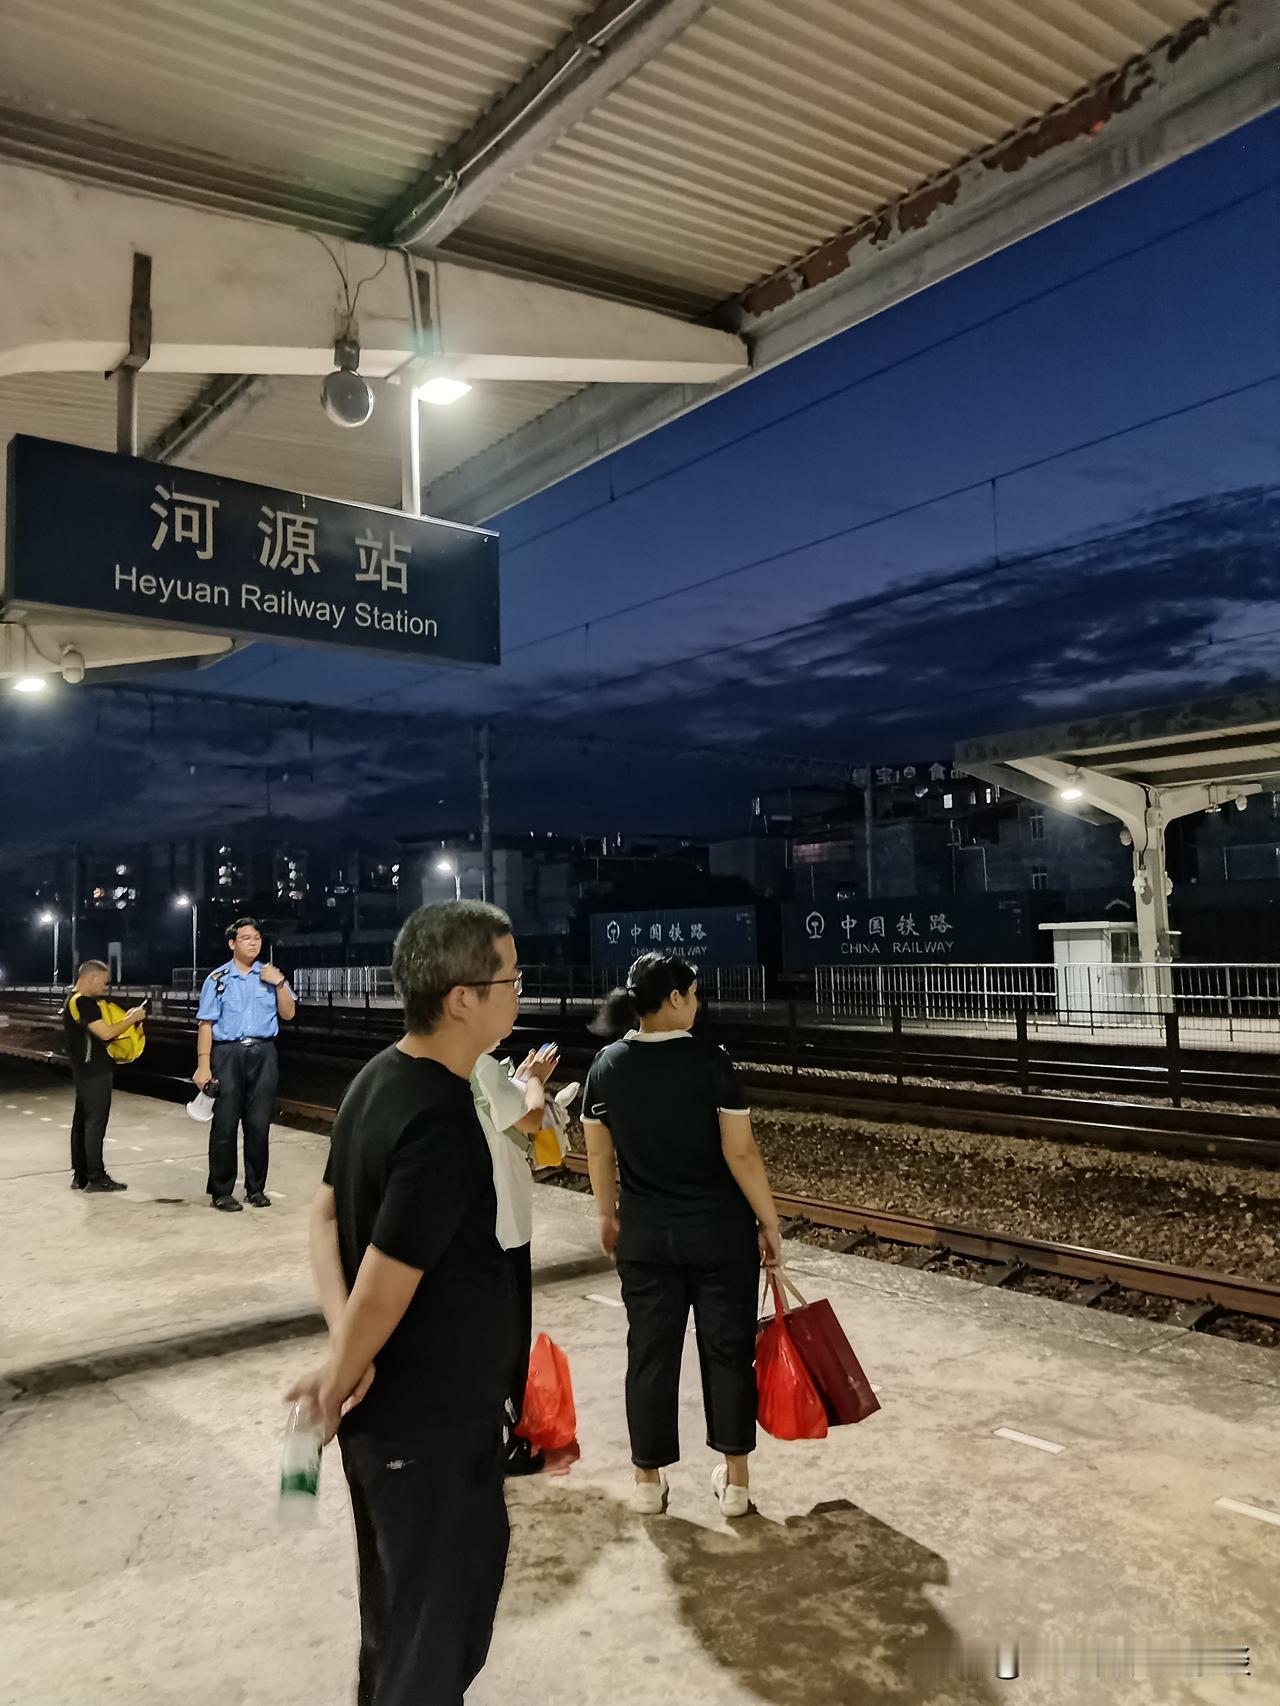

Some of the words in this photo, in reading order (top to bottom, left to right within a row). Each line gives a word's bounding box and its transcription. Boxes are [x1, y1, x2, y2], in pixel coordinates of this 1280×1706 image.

[150, 484, 412, 594] 河源站
[114, 564, 229, 606] Heyuan
[240, 584, 346, 628] Railway
[354, 602, 438, 637] Station
[631, 922, 707, 944] 中国铁路
[841, 913, 953, 939] 中国铁路
[841, 942, 880, 953] CHINA
[893, 941, 954, 953] RAILWAY
